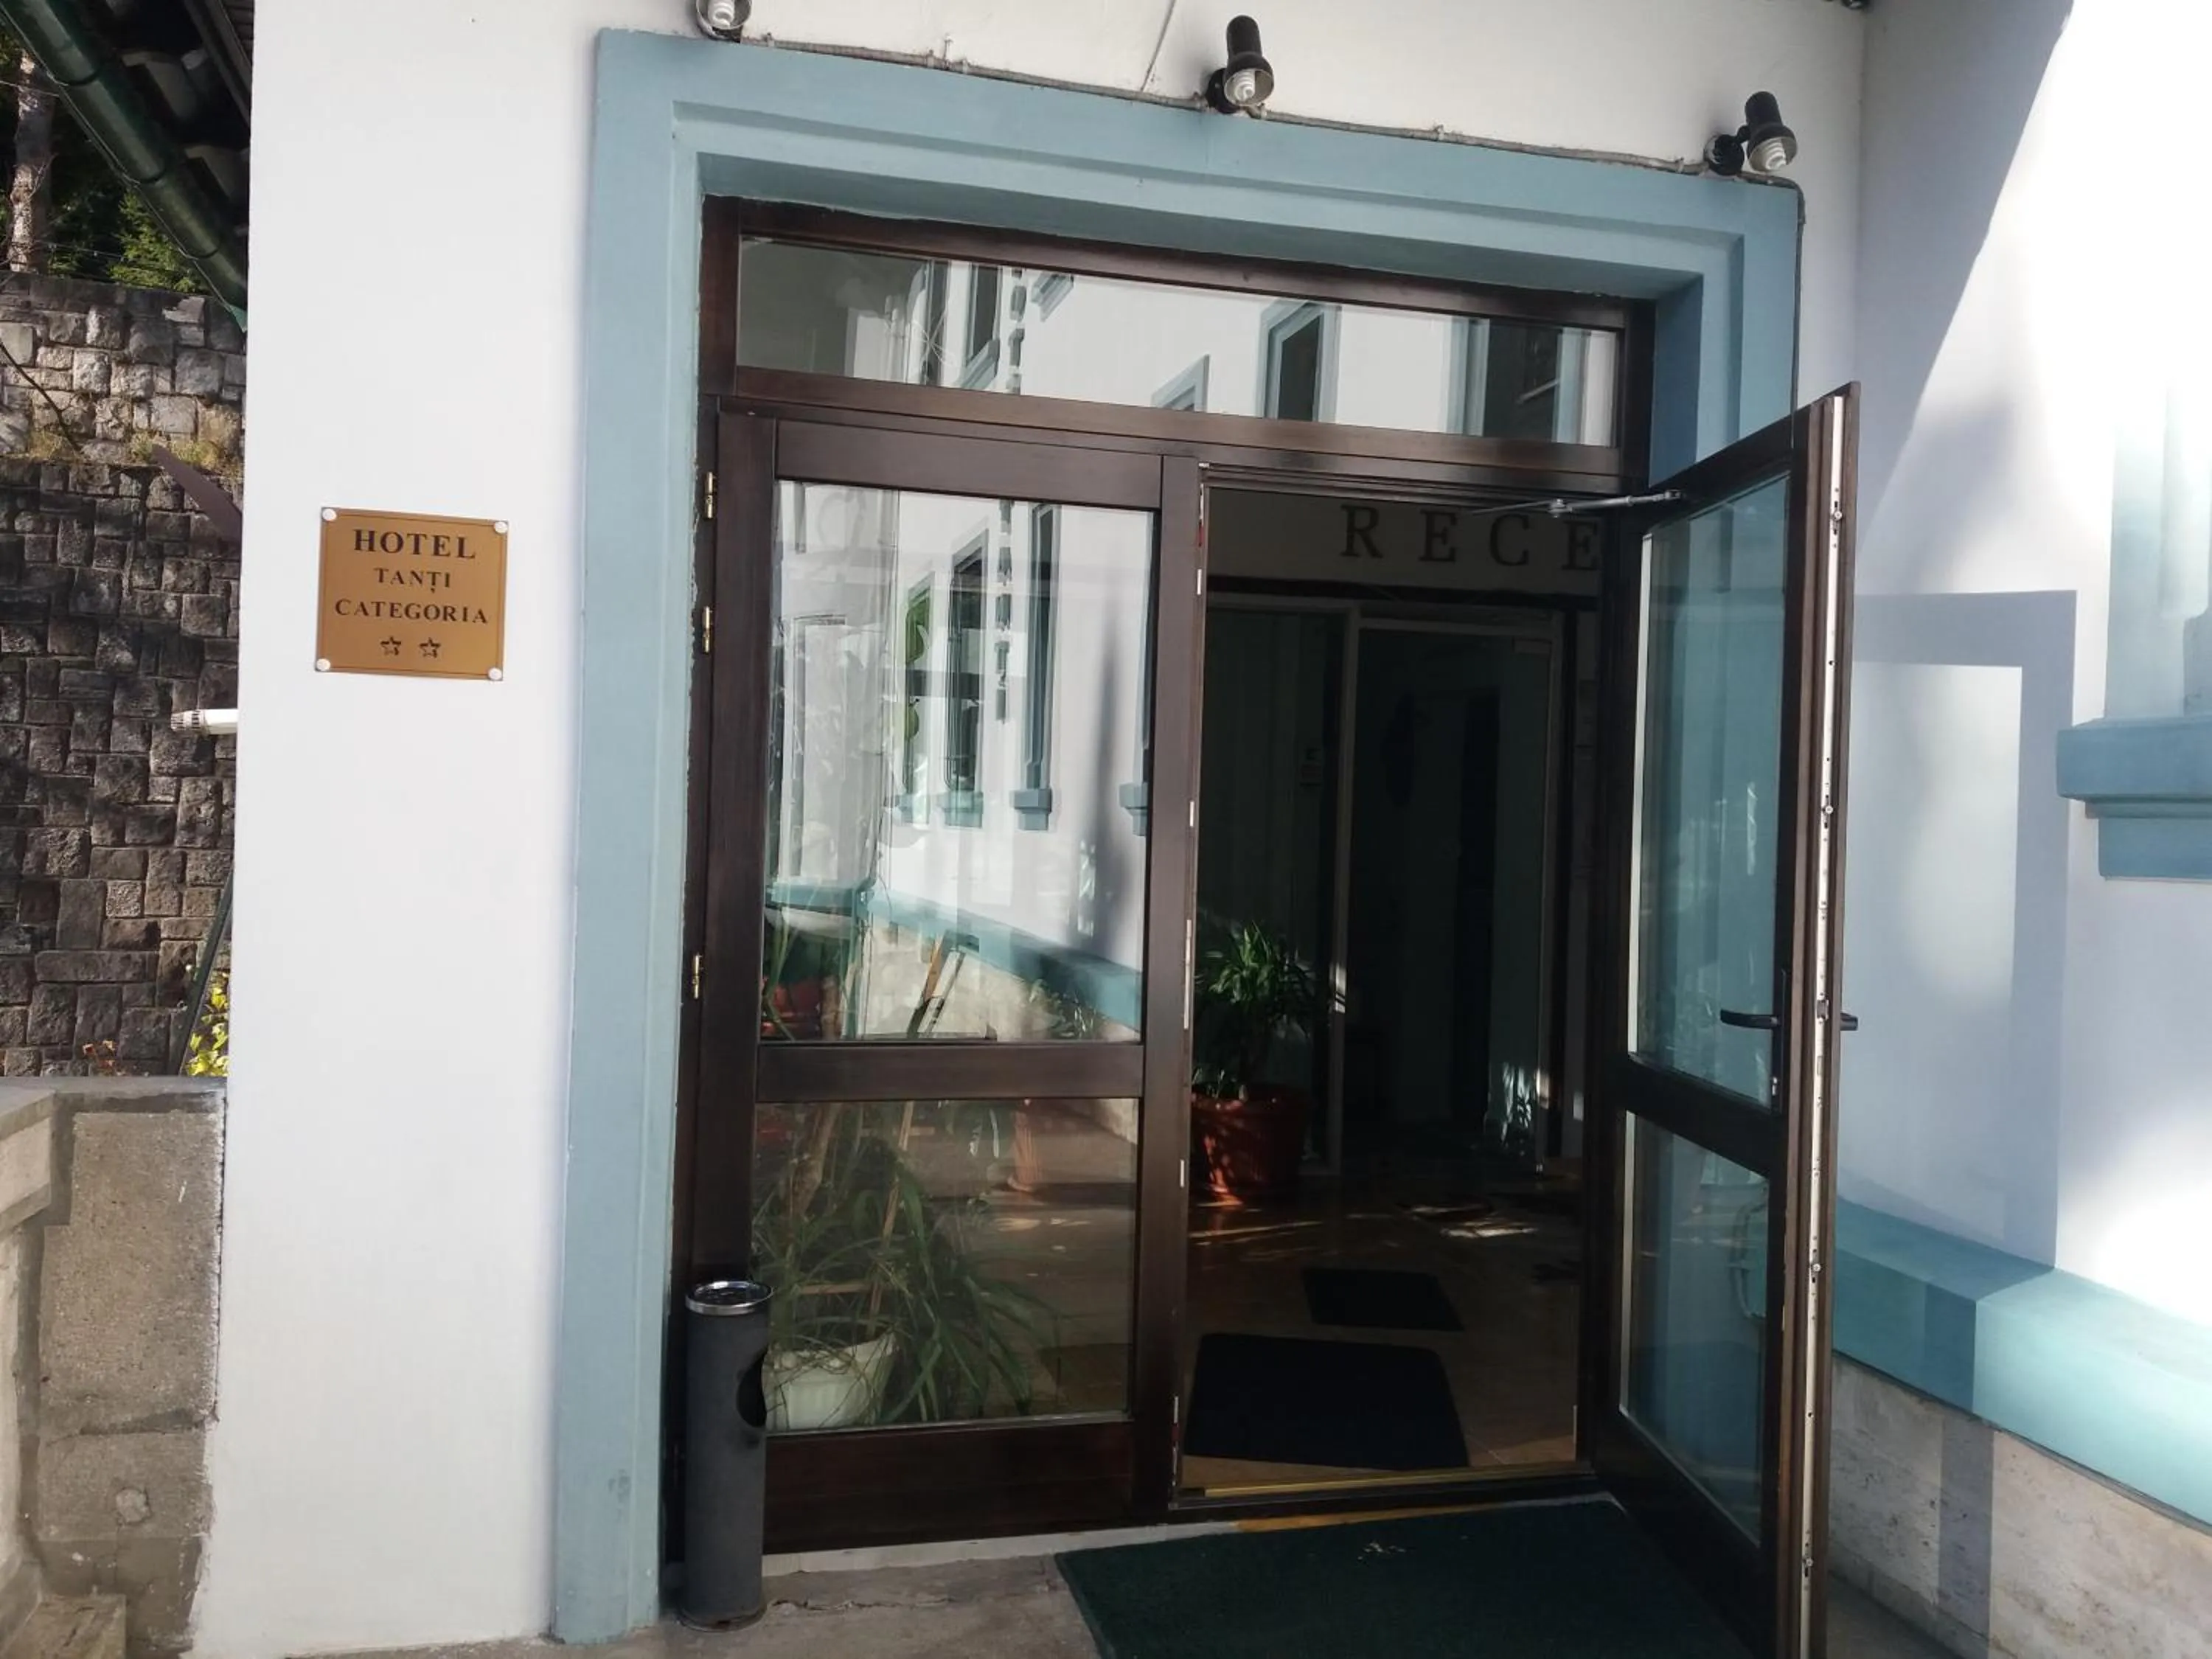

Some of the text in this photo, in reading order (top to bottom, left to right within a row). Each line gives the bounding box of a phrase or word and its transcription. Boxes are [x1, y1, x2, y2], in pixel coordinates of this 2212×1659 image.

[353, 529, 476, 559] HOTEL
[1340, 504, 1599, 571] RECE
[335, 598, 488, 624] CATEGORIA
